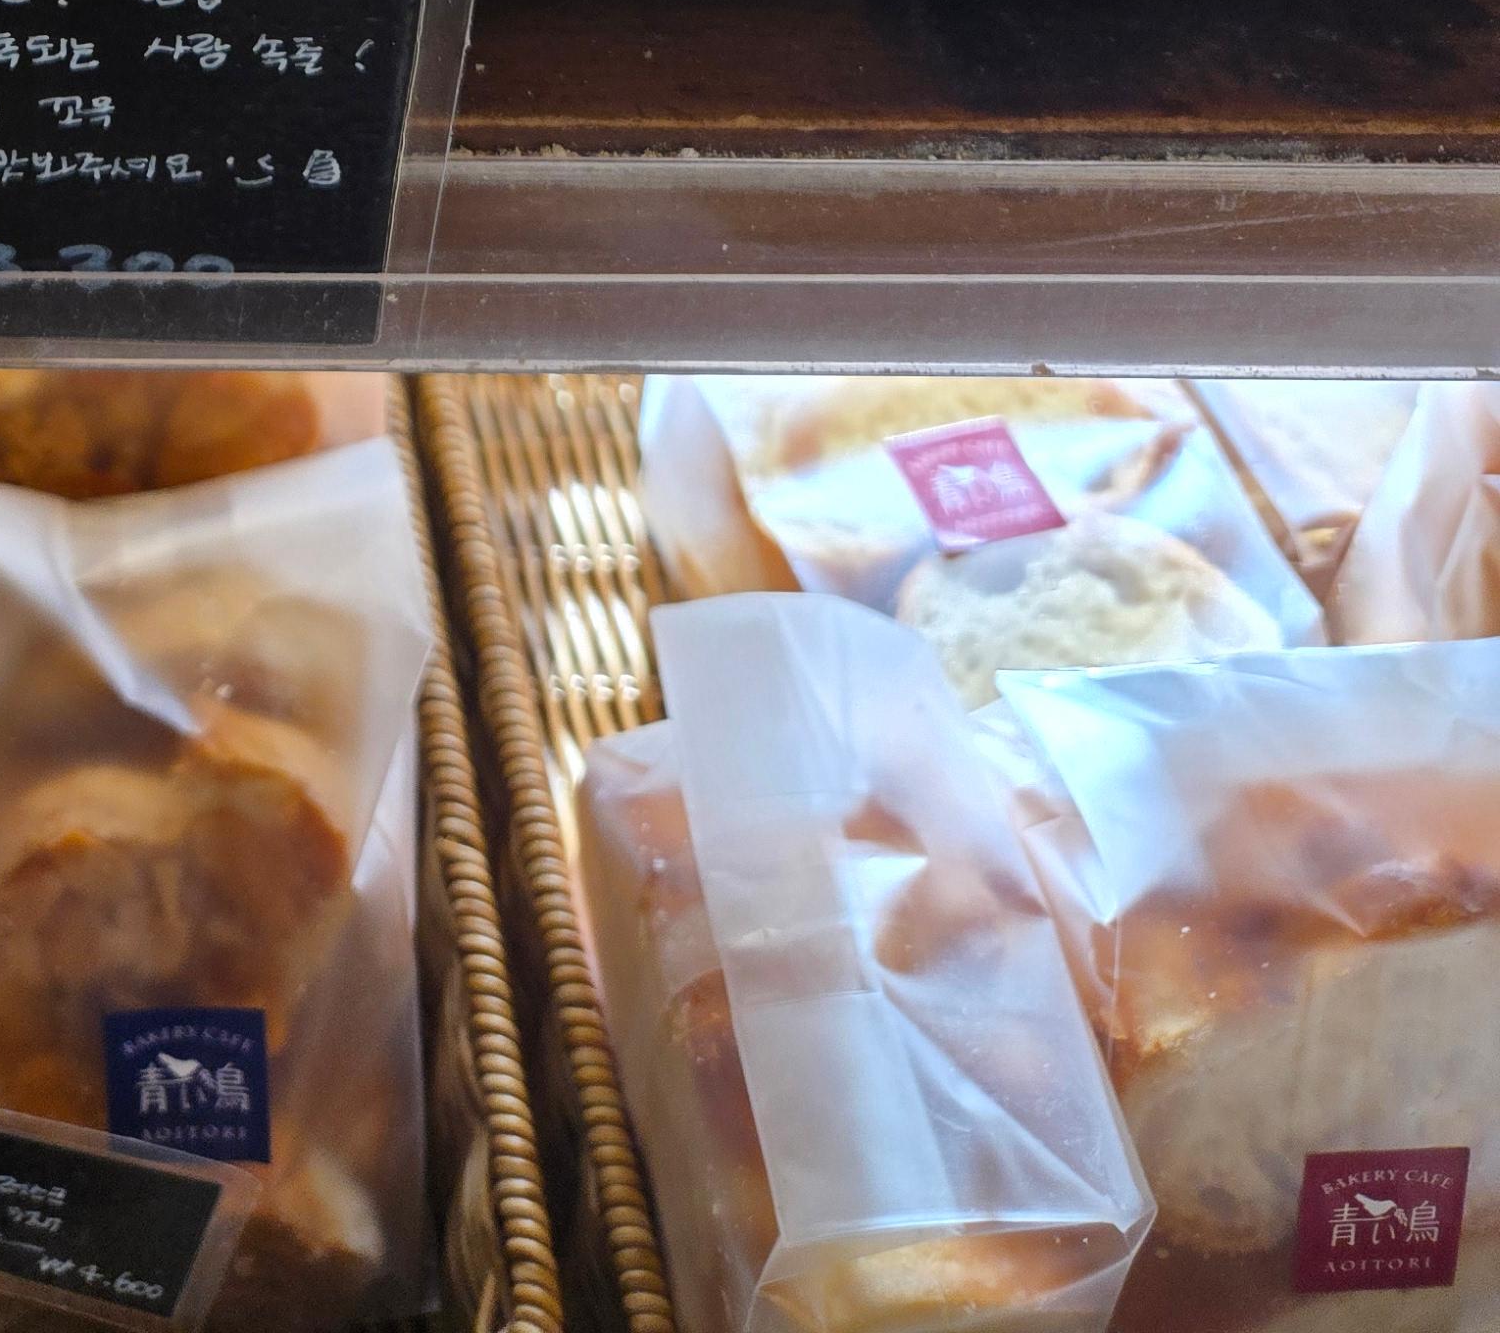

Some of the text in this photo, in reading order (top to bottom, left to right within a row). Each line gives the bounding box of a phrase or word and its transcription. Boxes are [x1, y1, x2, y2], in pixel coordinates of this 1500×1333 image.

[143, 32, 232, 70] 사랑
[1321, 1168, 1455, 1195] BAKERY CAFE
[1328, 1199, 1440, 1247] 青い鳥
[1323, 1255, 1435, 1274] AOITORI
